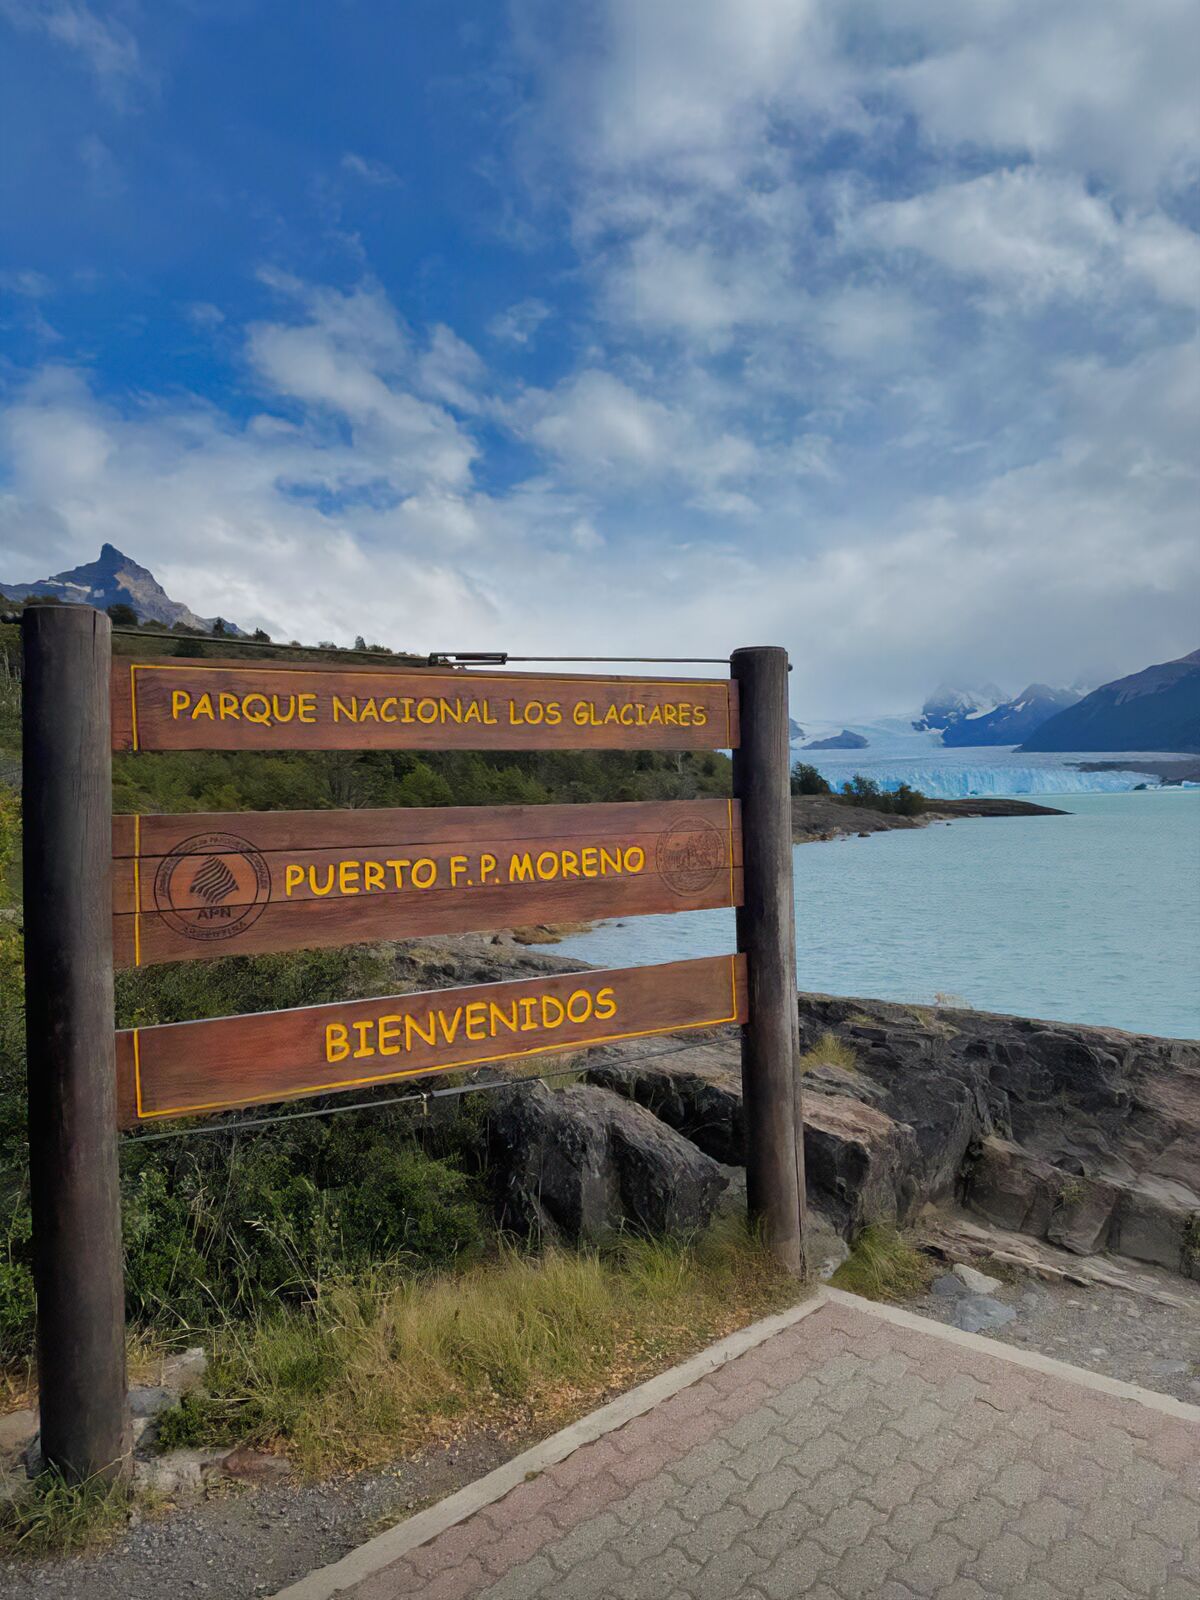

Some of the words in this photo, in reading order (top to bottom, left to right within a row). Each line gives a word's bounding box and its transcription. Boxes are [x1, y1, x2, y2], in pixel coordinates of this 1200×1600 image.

[171, 690, 317, 727] PARQUE
[332, 696, 499, 726] NACIONAL
[509, 701, 563, 726] LOS
[572, 700, 707, 727] GLACIARES
[284, 858, 438, 898] PUERTO
[508, 846, 646, 882] MORENO
[197, 907, 232, 920] APN
[324, 986, 620, 1064] BIENVENIDOS
